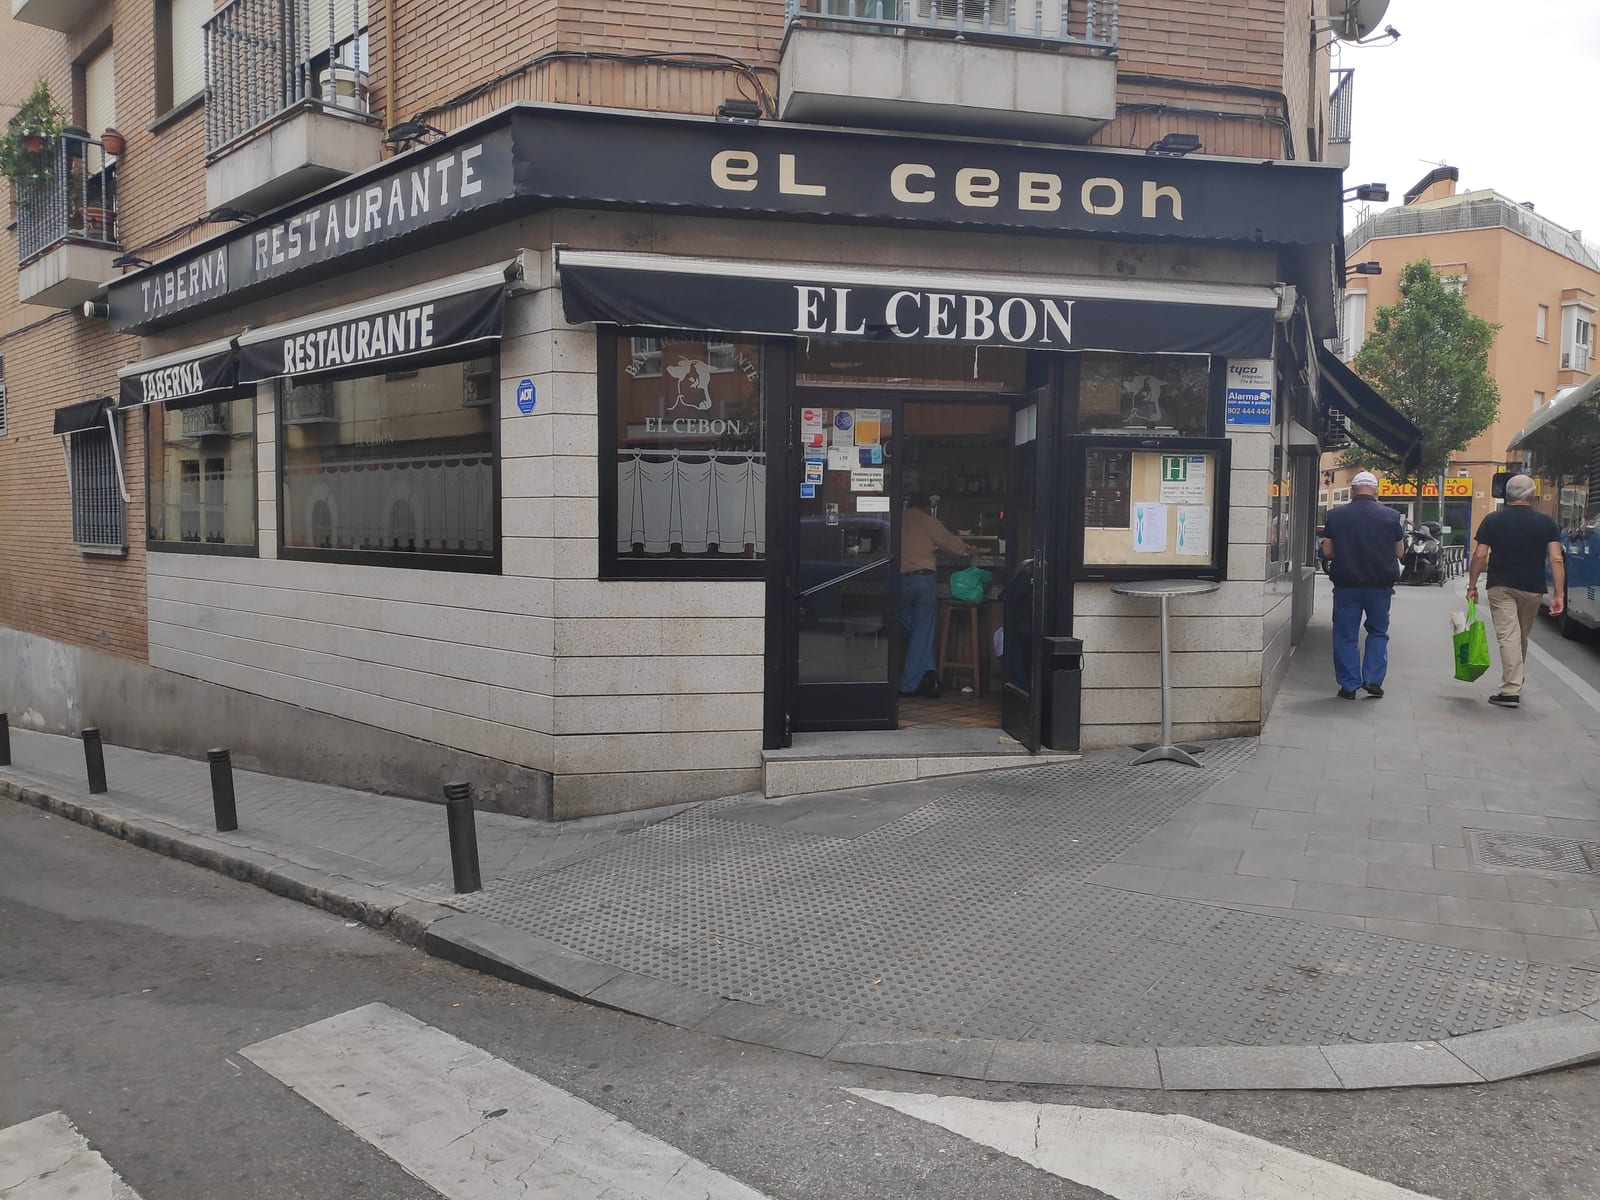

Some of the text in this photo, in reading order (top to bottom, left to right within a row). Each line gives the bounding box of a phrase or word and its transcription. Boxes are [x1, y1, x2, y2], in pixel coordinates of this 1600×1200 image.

[141, 143, 483, 314] TABERNA RESTAURANTE
[793, 285, 1077, 345] EL CEBON
[282, 304, 435, 374] RESTAURANTE
[1229, 365, 1258, 376] tyco
[140, 360, 204, 403] TABERNA
[519, 388, 534, 402] ADT
[1228, 392, 1259, 401] Alarma
[1227, 407, 1241, 415] 902
[1256, 408, 1270, 416] 440
[645, 417, 741, 435] EL CEBON
[1164, 457, 1186, 480] H
[1381, 485, 1469, 496] PALOMRO
